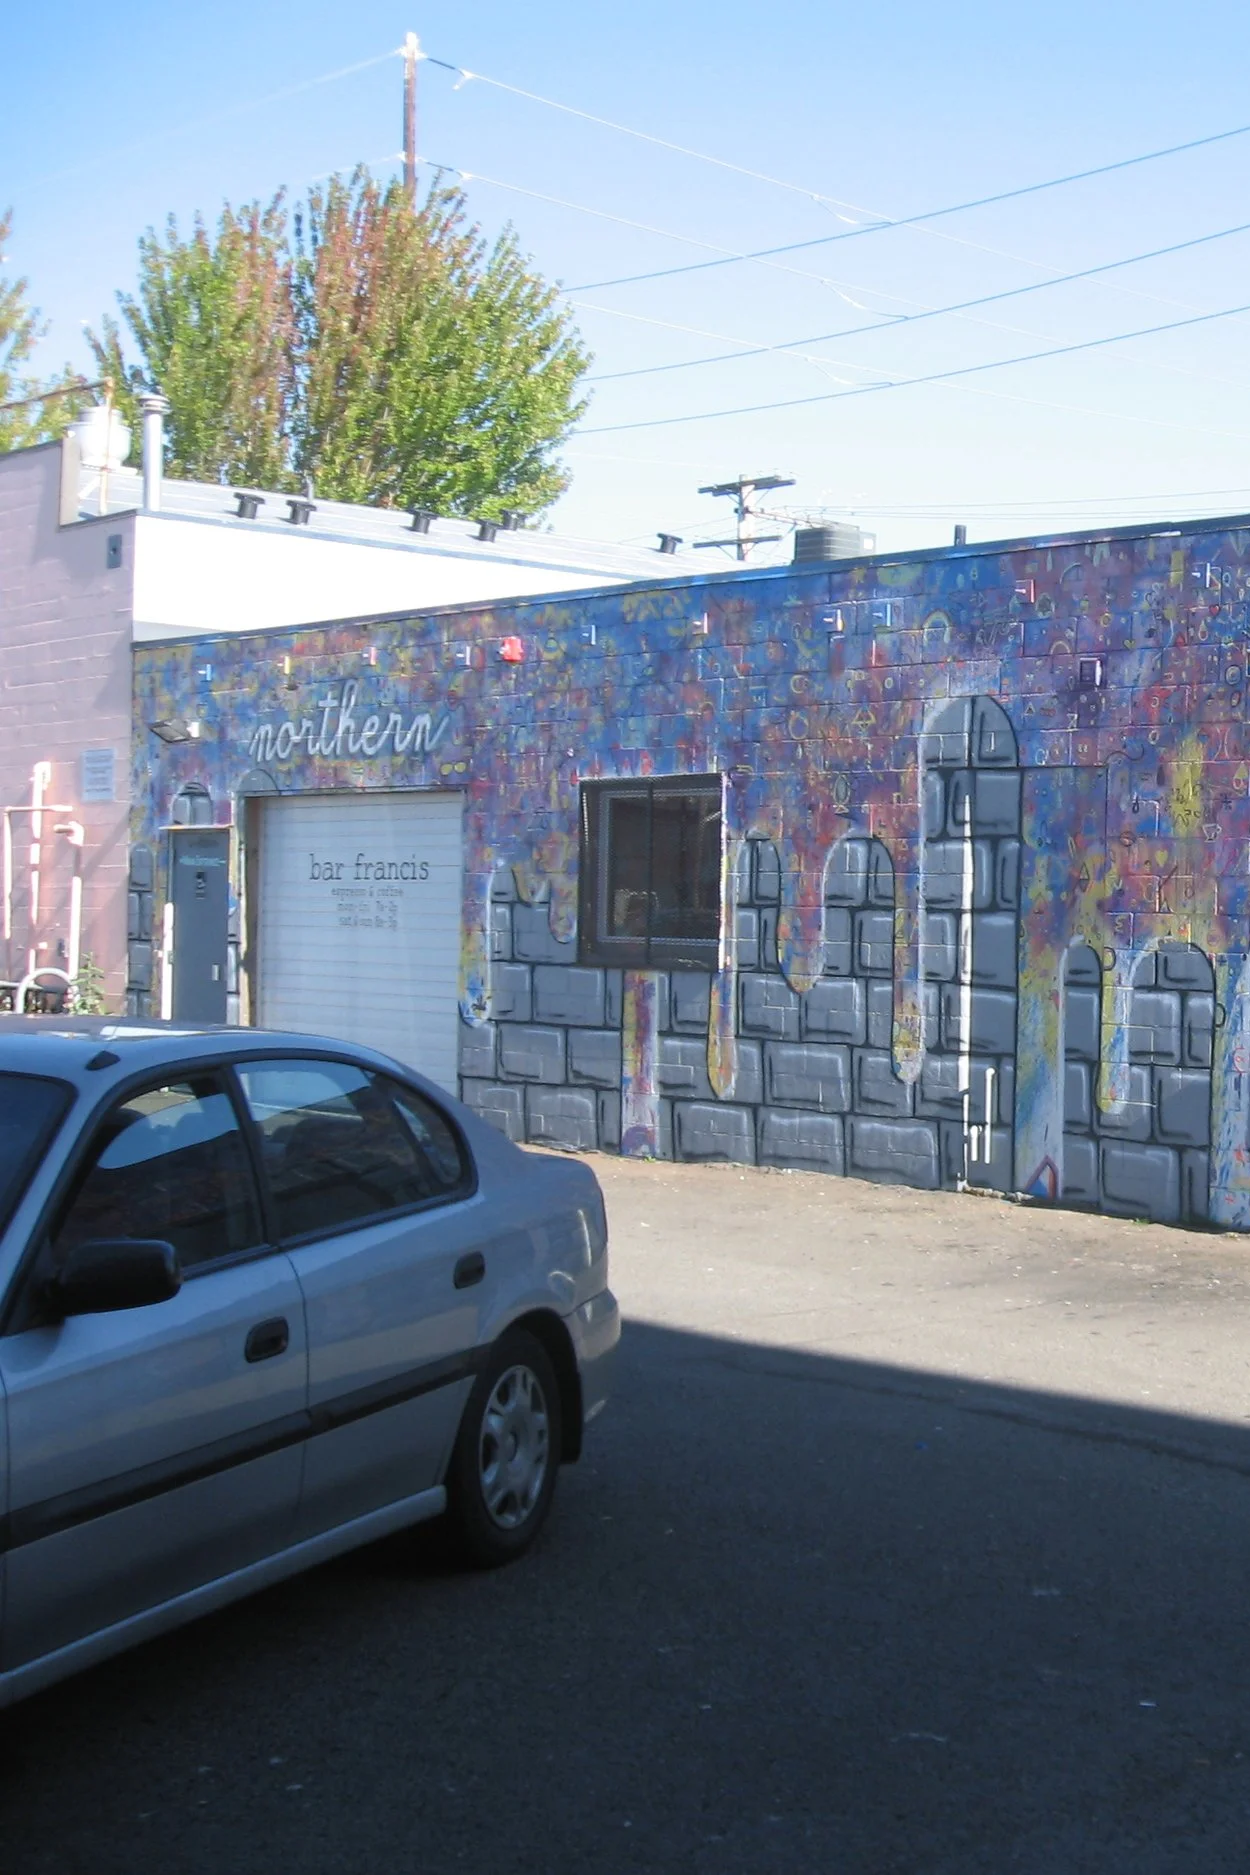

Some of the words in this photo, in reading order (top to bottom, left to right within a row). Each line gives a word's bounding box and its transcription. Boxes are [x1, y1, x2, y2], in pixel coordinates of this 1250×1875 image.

[249, 679, 449, 762] northern
[309, 853, 344, 881] bar
[354, 853, 429, 881] francis
